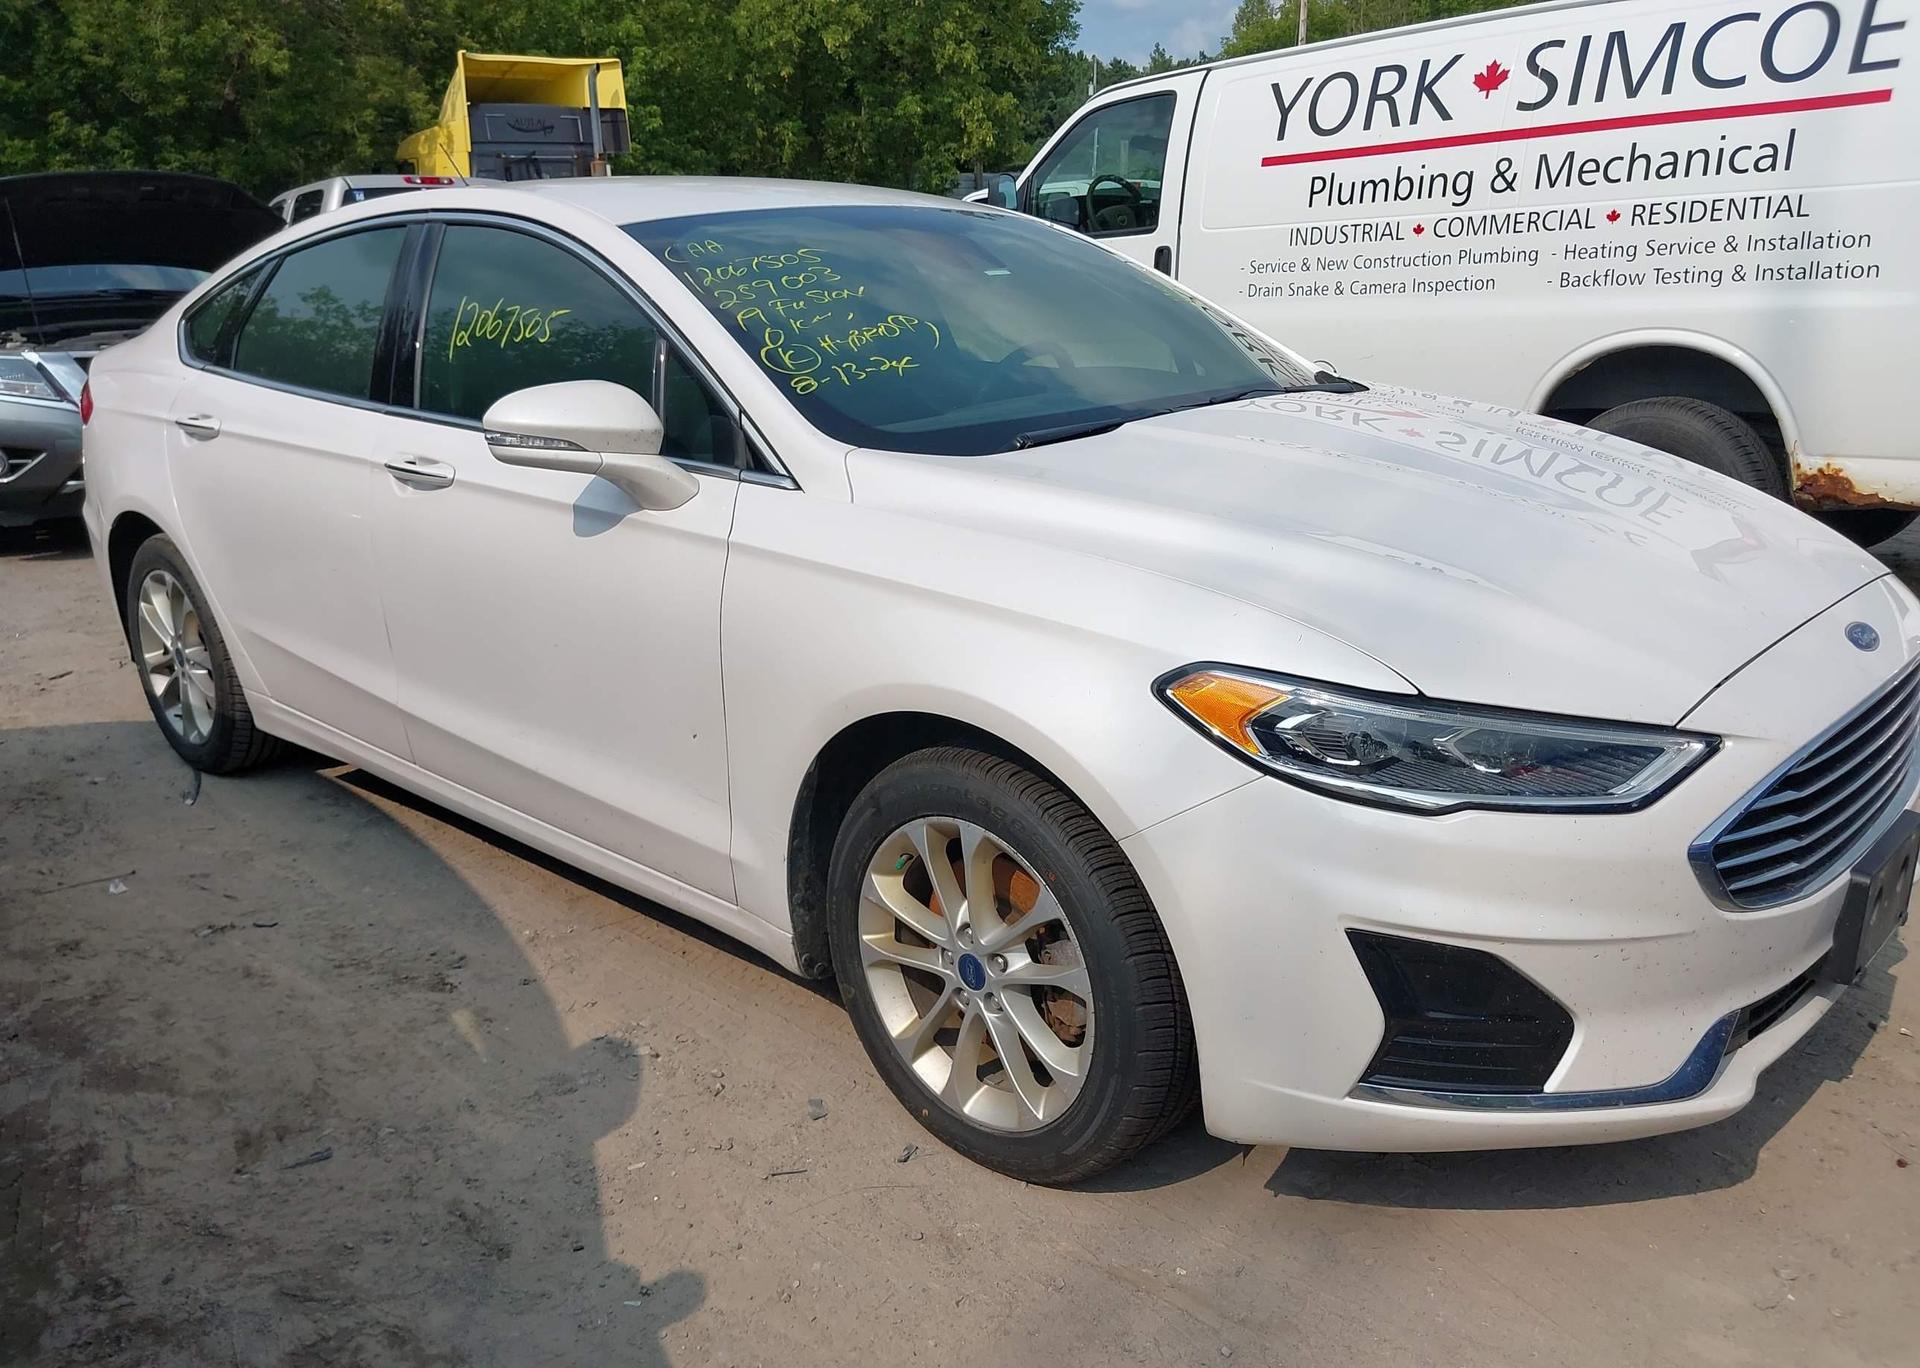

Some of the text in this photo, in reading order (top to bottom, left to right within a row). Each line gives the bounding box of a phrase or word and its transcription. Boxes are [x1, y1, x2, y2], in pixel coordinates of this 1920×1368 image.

[1270, 0, 1907, 142] YORK SIMCOE
[1308, 128, 1797, 208] Plumbing & Mechanical
[1289, 193, 1810, 247] INDUSTRIAL COMMERCIAL RESIDENTIAL
[1249, 246, 1539, 274] Service & New Construction Plumbing
[1564, 230, 1871, 263] Heating Service & Installation
[1247, 275, 1495, 298] Drain Snake & Camera Inspection
[1559, 260, 1880, 288] Backflow Testing & Installation
[449, 295, 572, 363] 12067505
